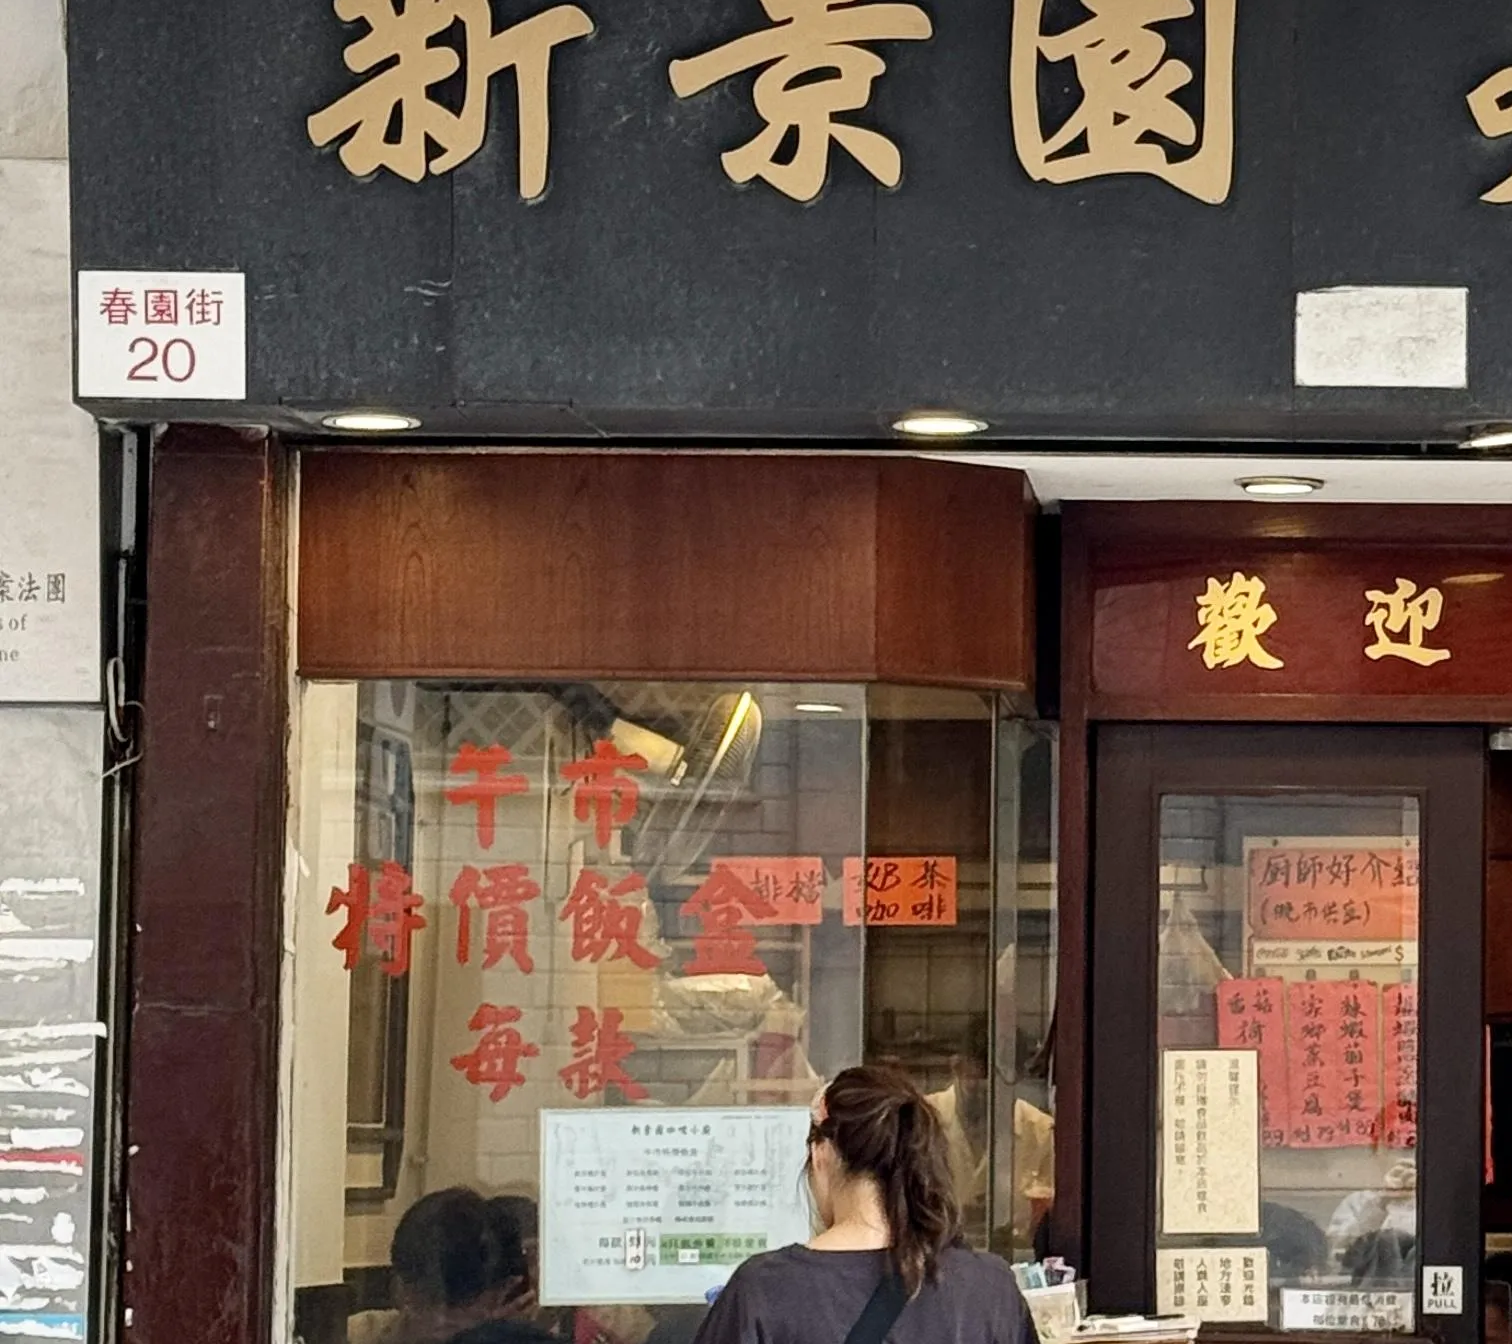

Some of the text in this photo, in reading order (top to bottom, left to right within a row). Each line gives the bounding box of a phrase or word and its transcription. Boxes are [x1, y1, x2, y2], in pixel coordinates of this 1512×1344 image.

[99, 288, 223, 327] 春園街
[127, 337, 196, 382] 20
[445, 738, 649, 851] 午市
[326, 860, 780, 977] 特價飯盒
[450, 1001, 650, 1103] 每款
[1427, 1297, 1457, 1309] PULL
[1431, 1270, 1454, 1297] 拉
